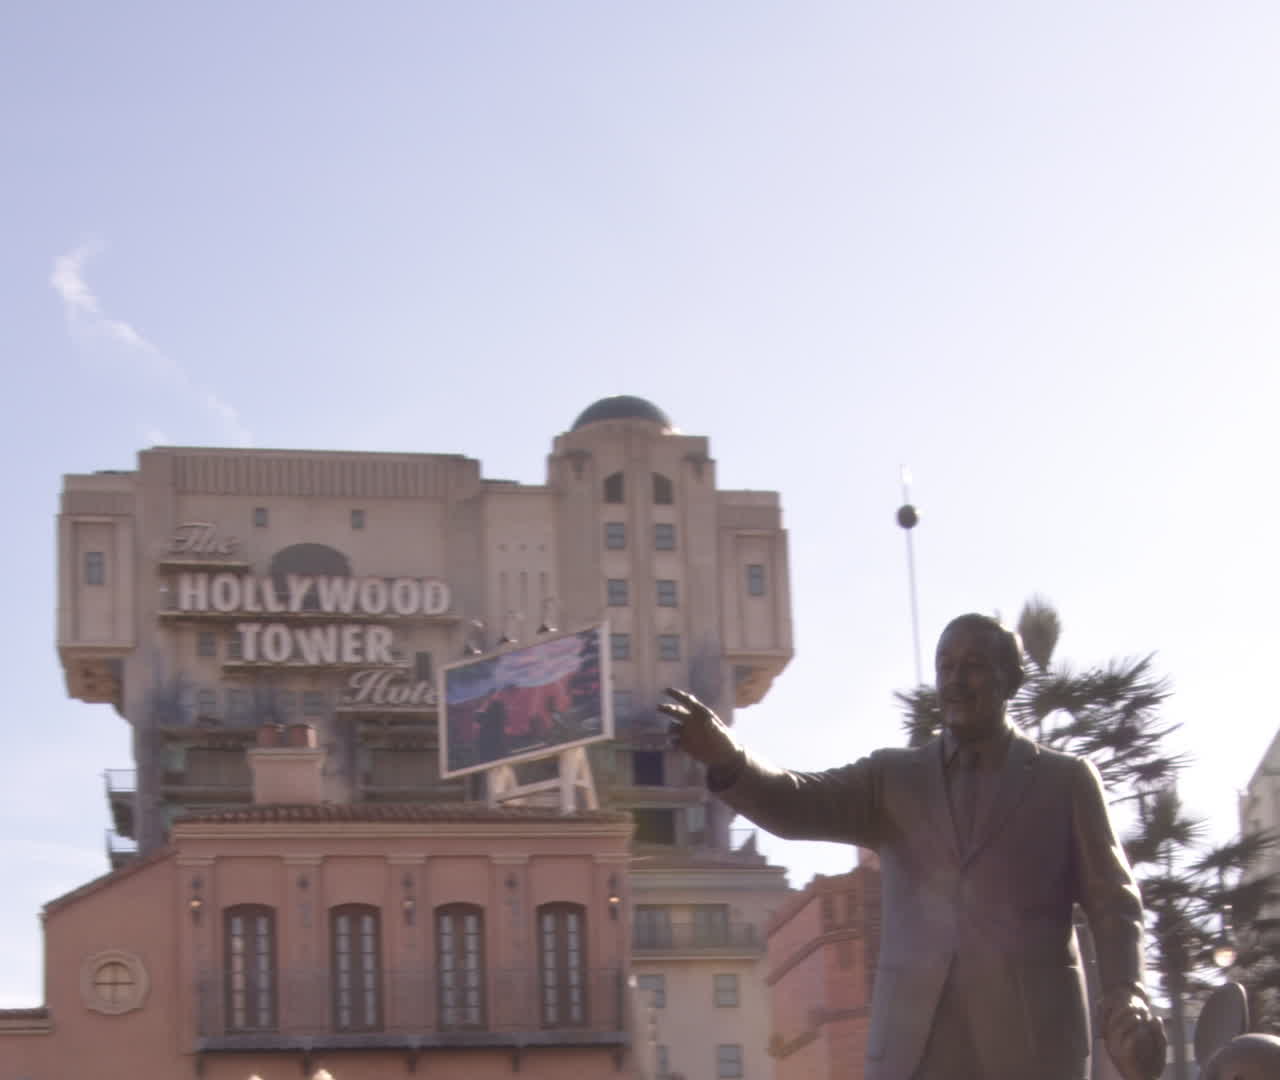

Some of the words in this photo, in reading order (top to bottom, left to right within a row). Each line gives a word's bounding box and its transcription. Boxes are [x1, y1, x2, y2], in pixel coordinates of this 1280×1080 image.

[167, 521, 242, 555] The
[177, 572, 452, 616] HOLLYWOOD
[236, 622, 394, 664] TOWER
[342, 671, 439, 706] Hote
